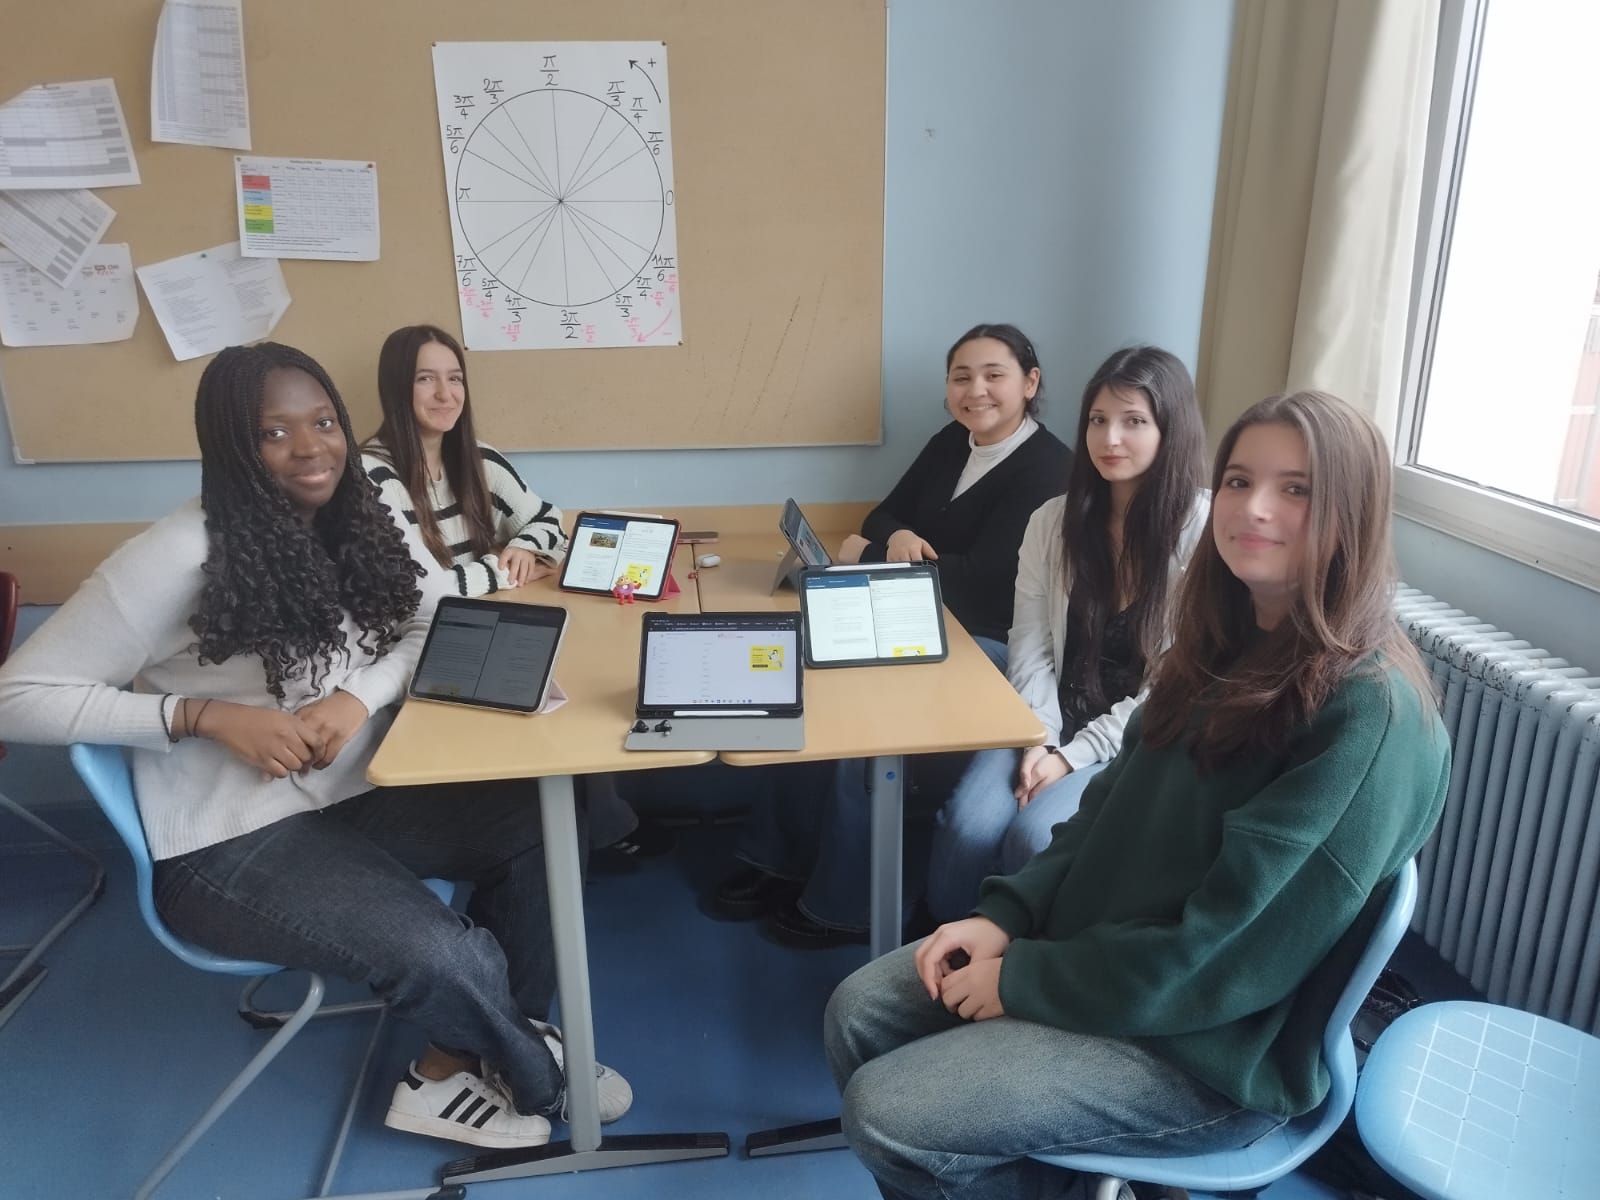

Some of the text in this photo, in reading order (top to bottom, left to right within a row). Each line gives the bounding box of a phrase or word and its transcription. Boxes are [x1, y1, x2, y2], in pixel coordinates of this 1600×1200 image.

[545, 73, 559, 86] 2
[490, 93, 499, 105] 3
[611, 95, 621, 107] 3
[460, 108, 469, 120] 4
[450, 140, 459, 154] 6
[653, 144, 660, 156] 6
[462, 272, 471, 287] 6
[657, 269, 665, 281] 6
[620, 307, 630, 318] 3
[565, 326, 579, 339] 2
